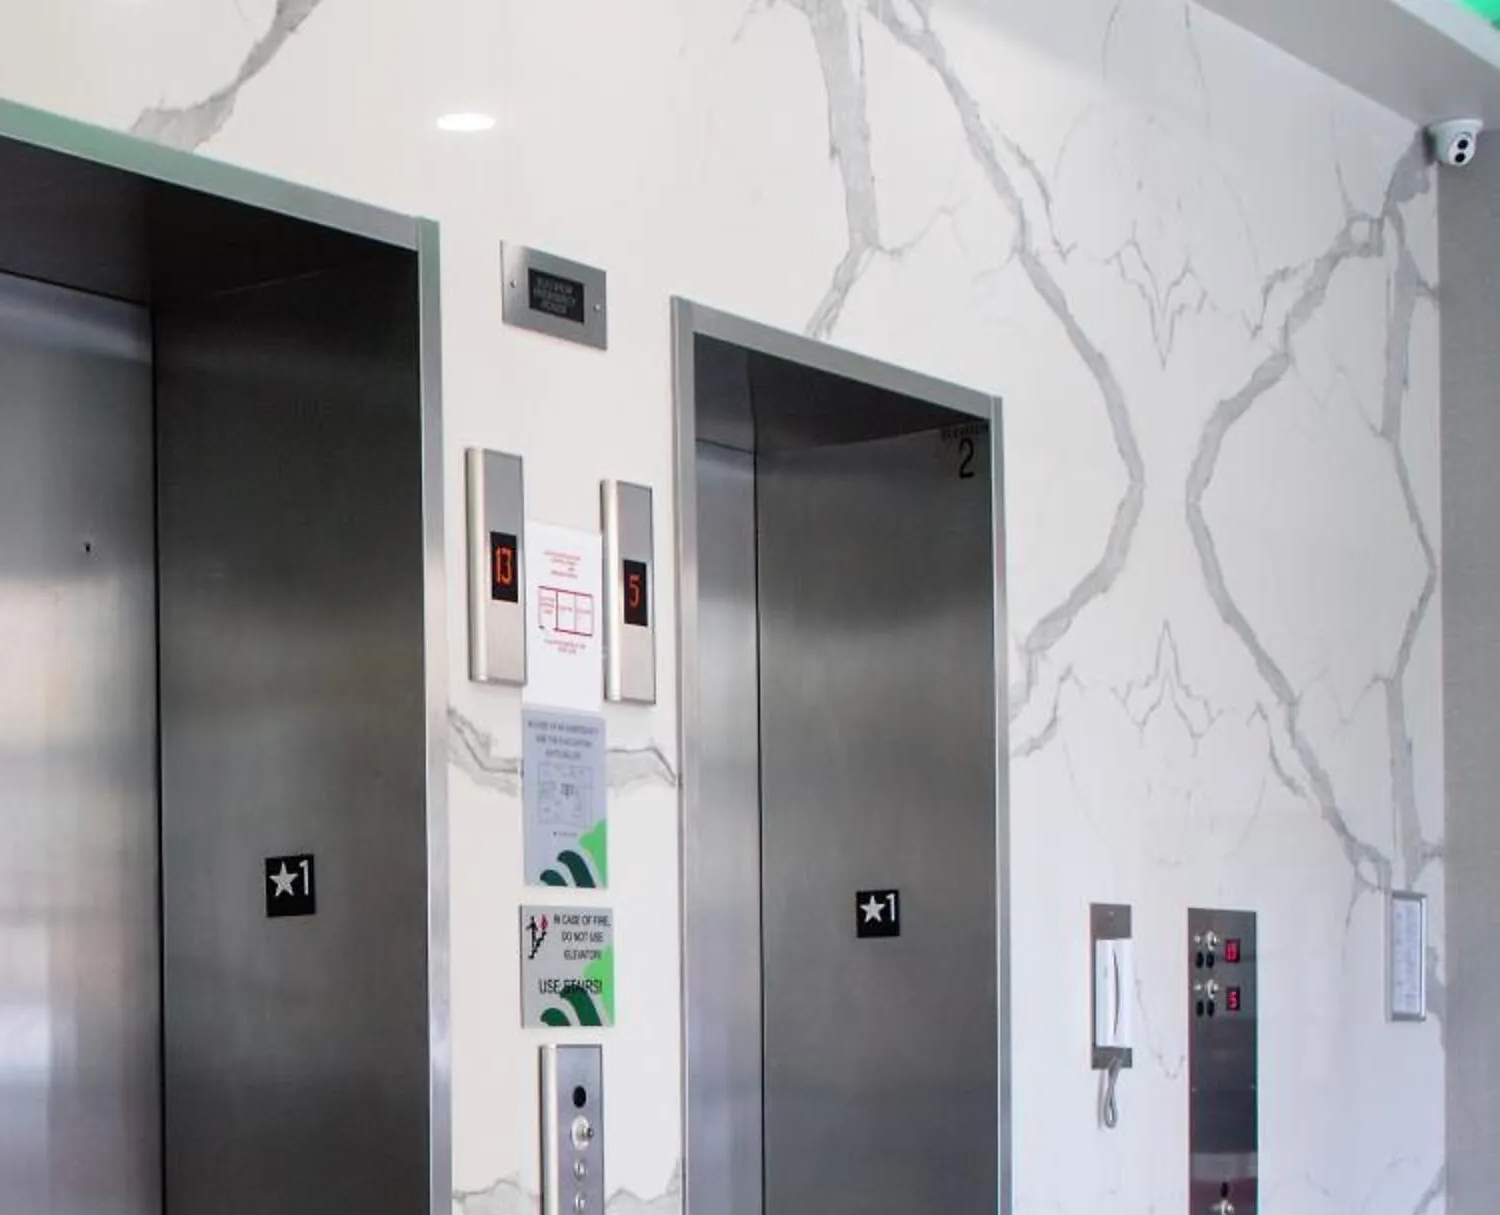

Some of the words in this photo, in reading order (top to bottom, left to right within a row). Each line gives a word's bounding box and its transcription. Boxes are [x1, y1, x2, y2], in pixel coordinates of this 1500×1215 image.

[958, 437, 975, 479] 2
[495, 545, 513, 586] 13
[628, 573, 641, 608] 5
[299, 859, 309, 896] 1
[553, 914, 561, 925] IN
[562, 914, 580, 926] CASE
[581, 915, 593, 926] OF
[885, 893, 896, 922] 1
[561, 931, 572, 943] DO
[573, 931, 588, 943] NOT
[589, 932, 604, 943] USE
[538, 979, 560, 995] USE
